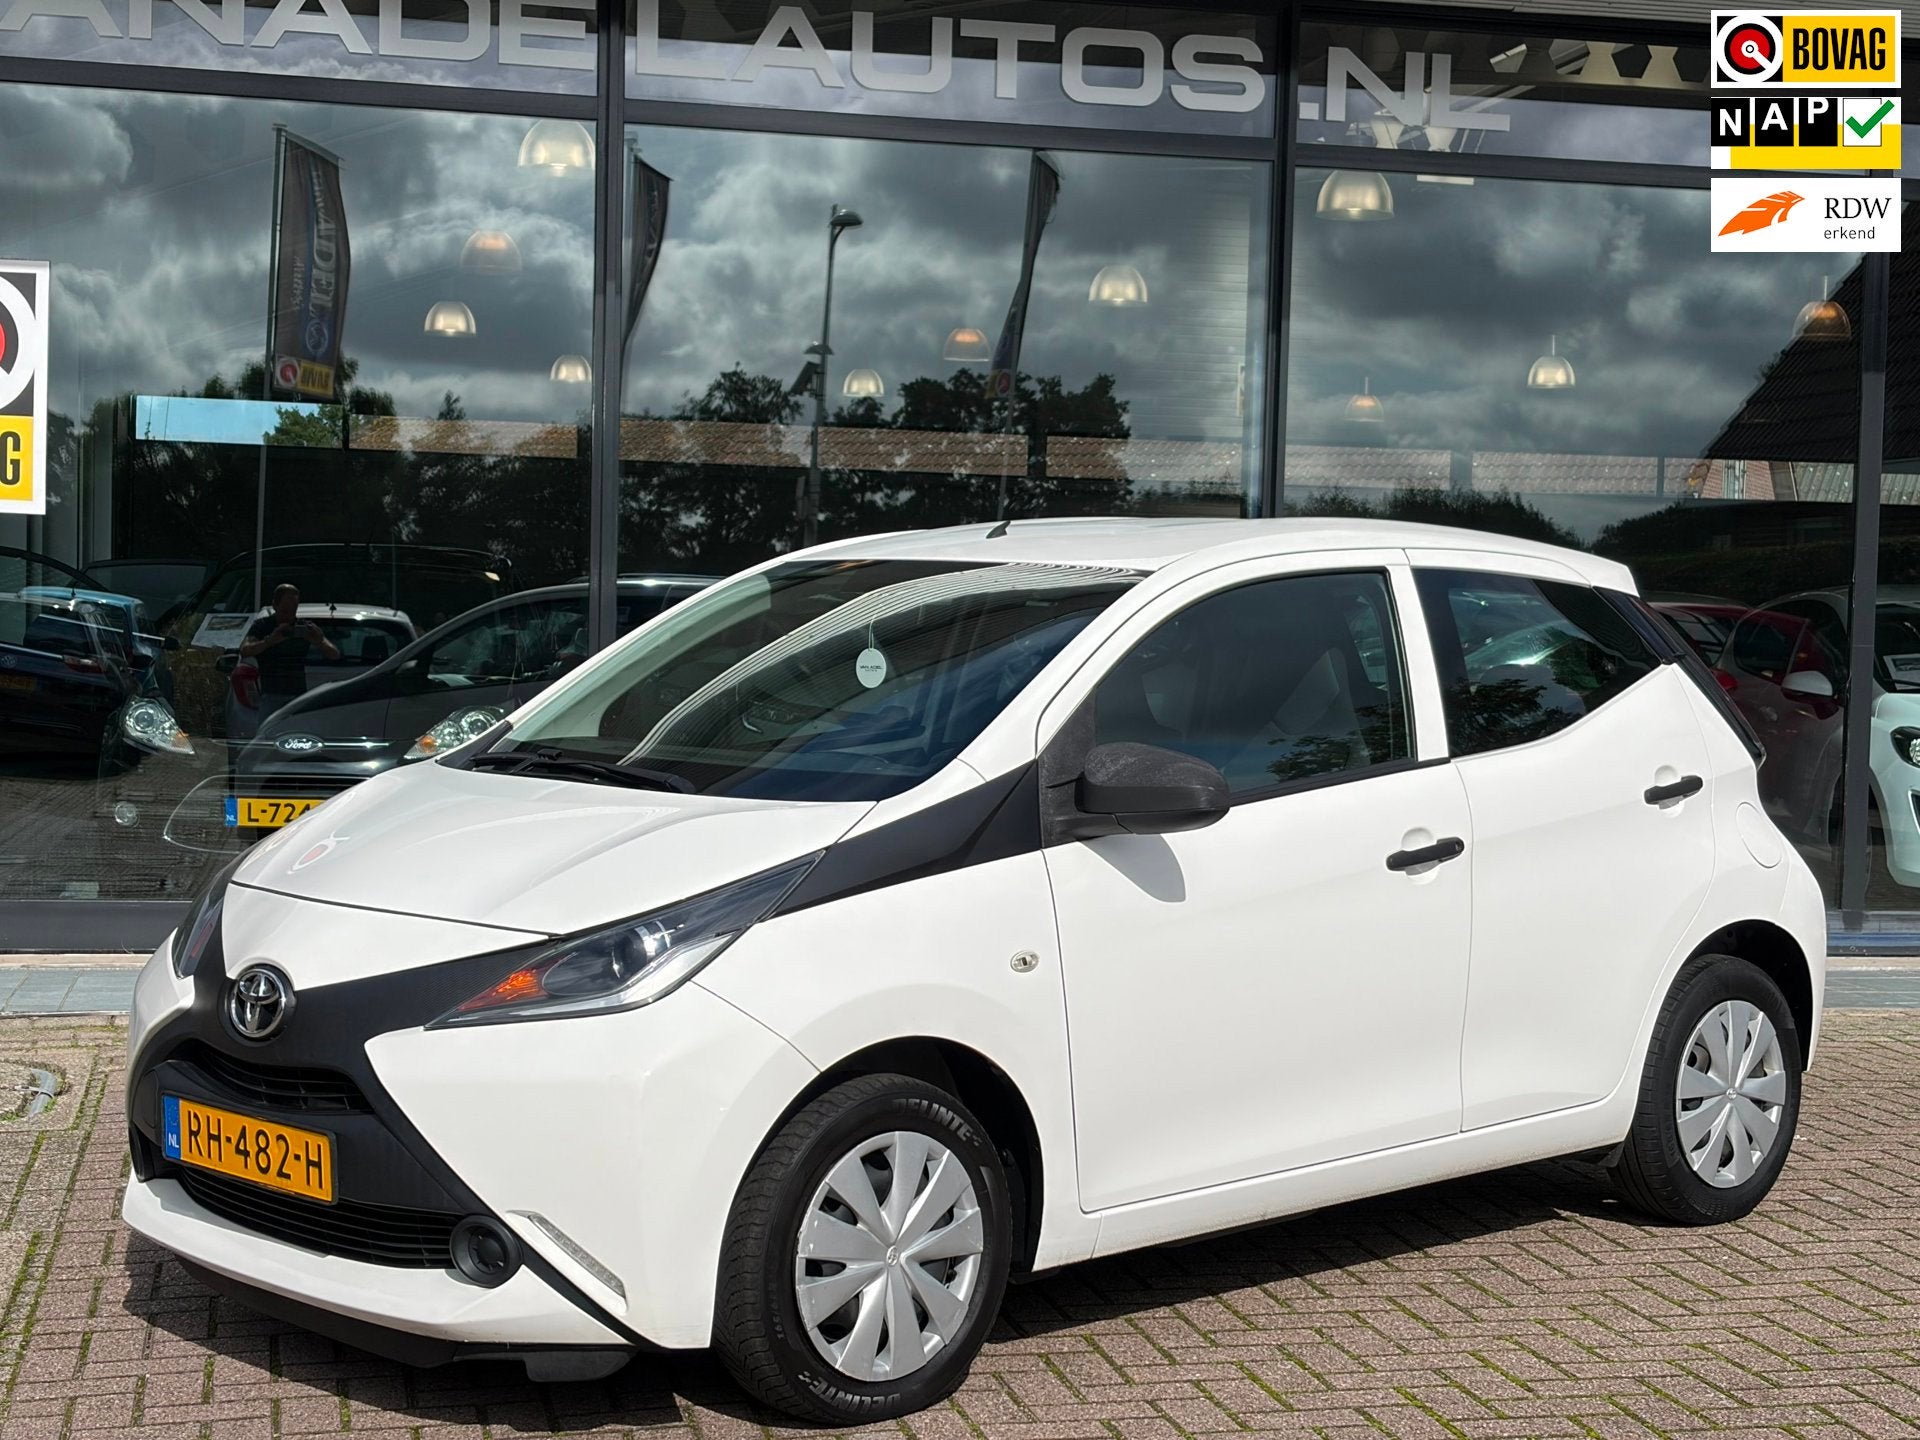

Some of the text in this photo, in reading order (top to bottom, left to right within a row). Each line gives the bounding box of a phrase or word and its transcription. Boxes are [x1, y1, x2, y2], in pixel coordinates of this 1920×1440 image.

[284, 738, 313, 749] Ford
[168, 1132, 180, 1148] NL
[187, 1109, 324, 1190] RH-482-H
